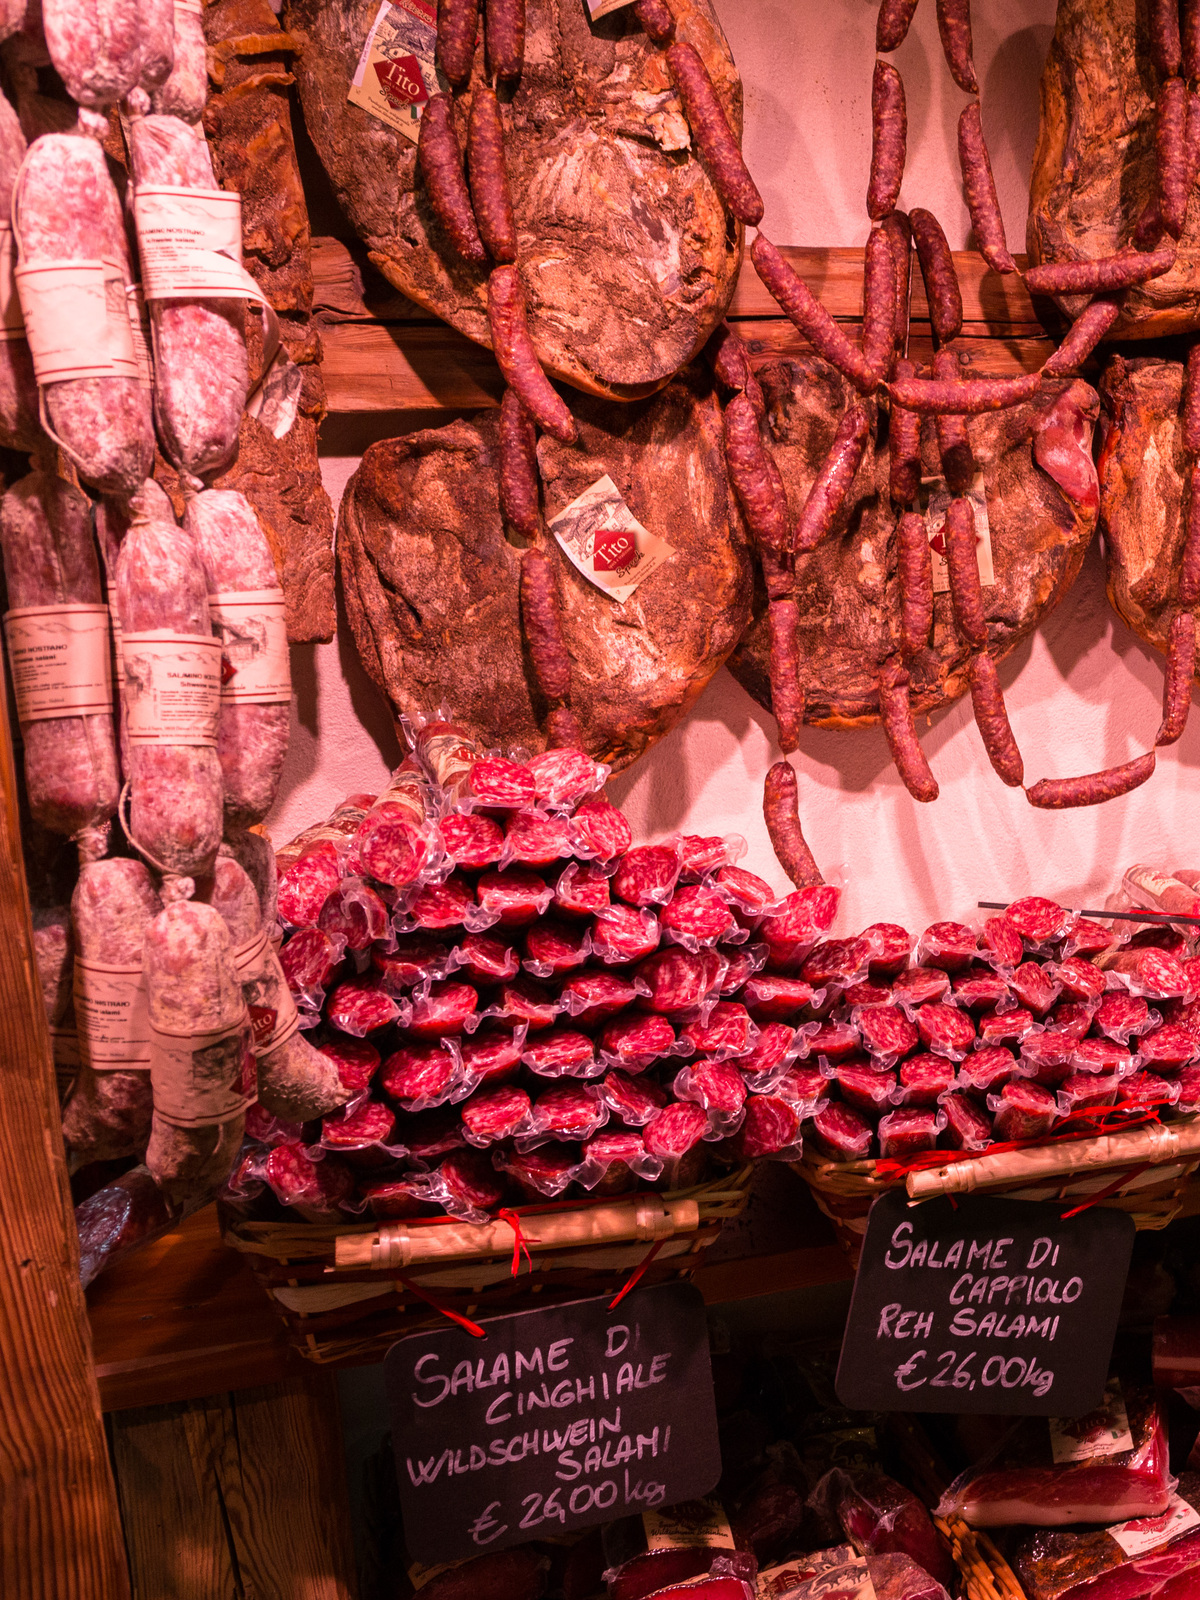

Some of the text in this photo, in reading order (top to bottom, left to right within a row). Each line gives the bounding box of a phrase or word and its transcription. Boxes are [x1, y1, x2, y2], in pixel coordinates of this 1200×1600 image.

[380, 85, 409, 110] Speck
[387, 60, 420, 96] Tito
[594, 537, 629, 564] Tito
[616, 551, 645, 578] Speck
[251, 1014, 272, 1031] ito
[884, 1221, 1060, 1270] SALAME DI
[876, 1302, 1060, 1341] REH SALAMI
[412, 1322, 640, 1408] SALAME DI
[485, 1352, 672, 1425] CINGHIALE
[406, 1406, 622, 1487] WILDSCHWEIN
[555, 1424, 672, 1481] SALAMI
